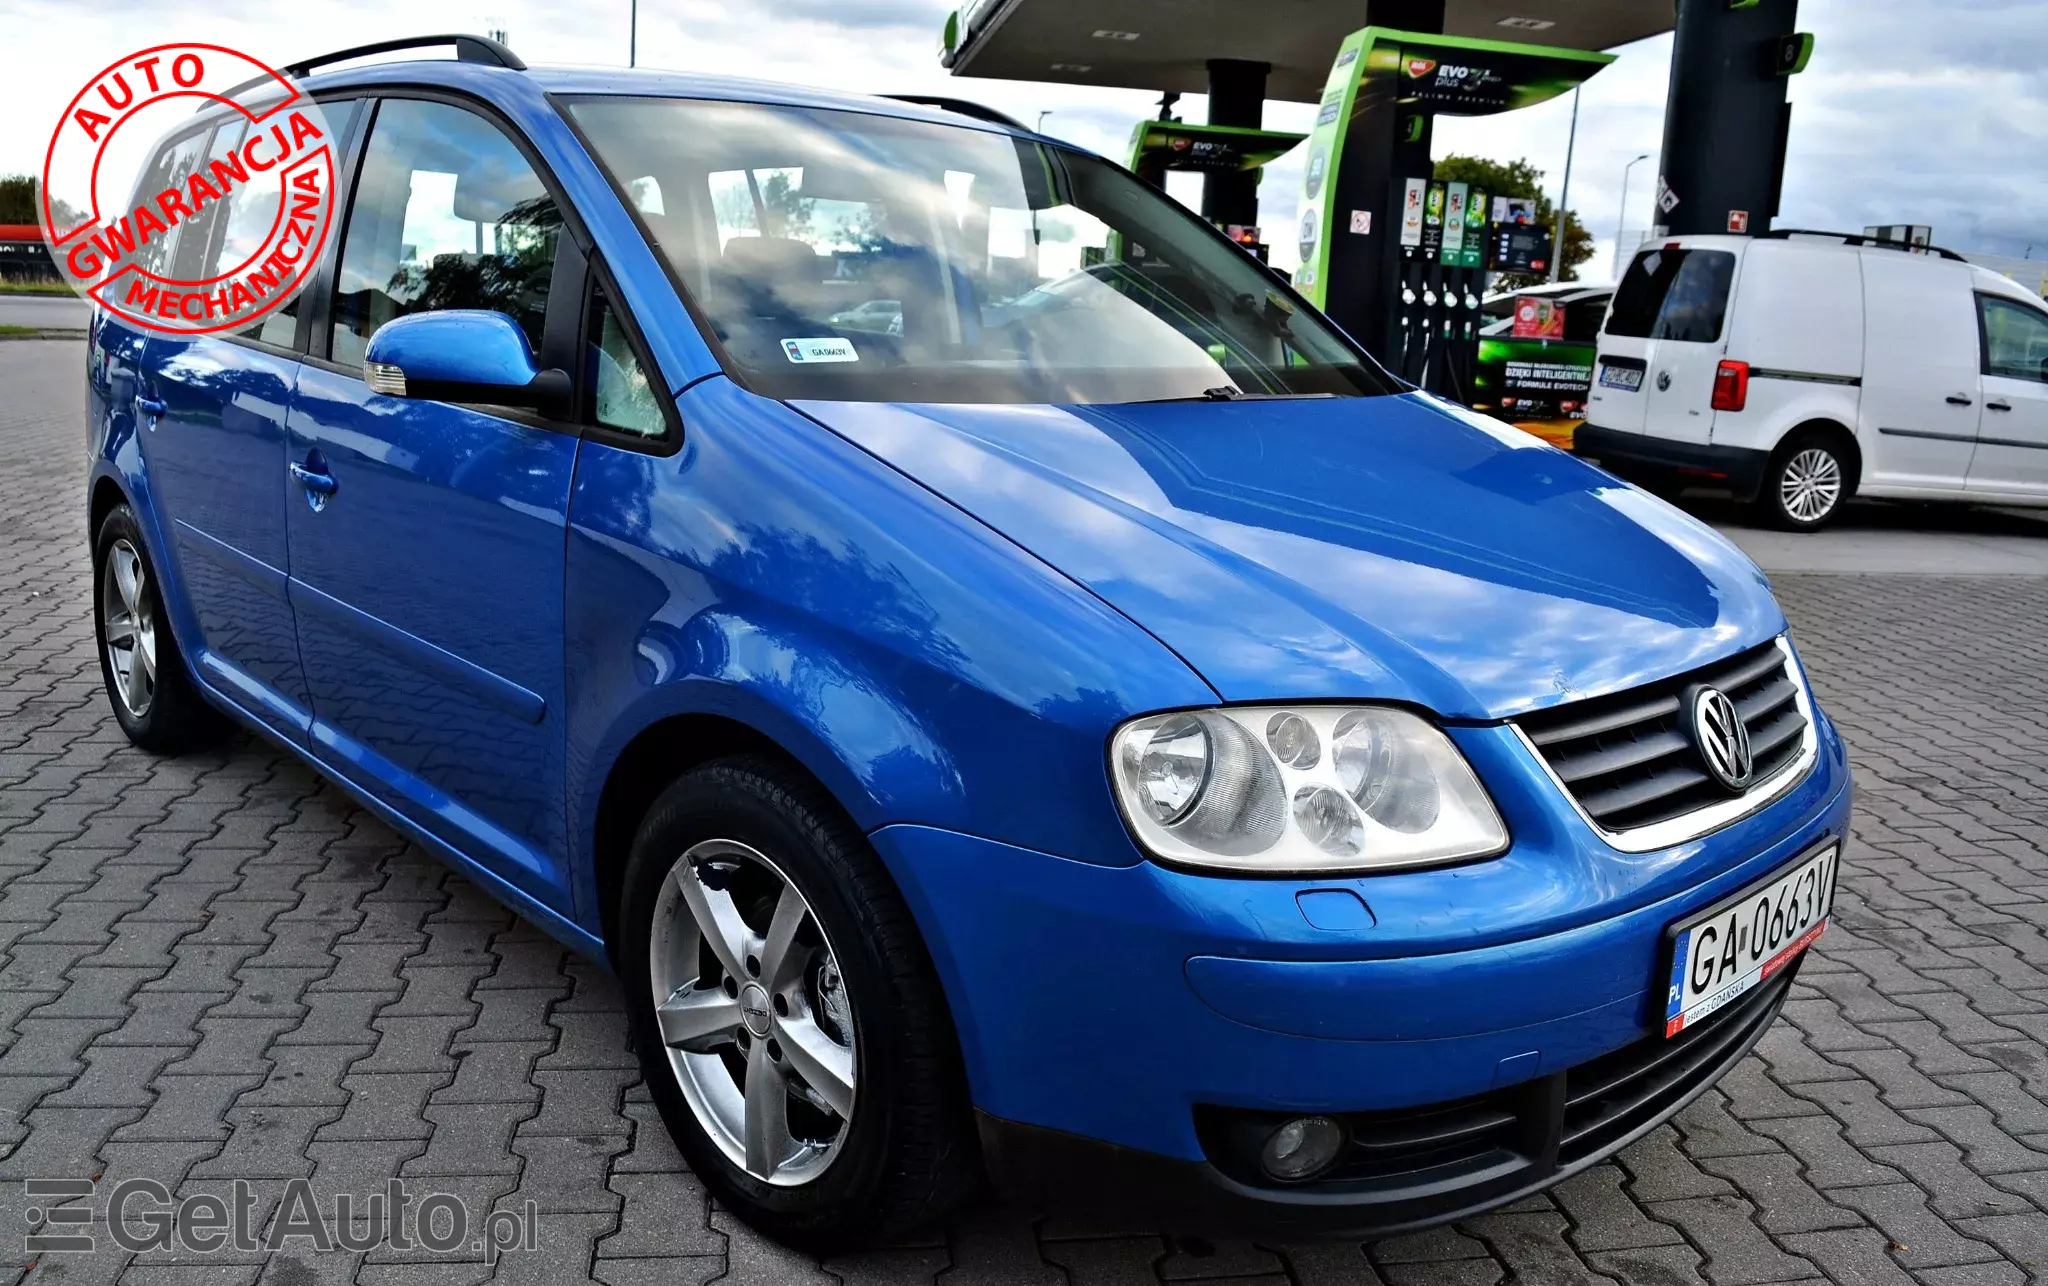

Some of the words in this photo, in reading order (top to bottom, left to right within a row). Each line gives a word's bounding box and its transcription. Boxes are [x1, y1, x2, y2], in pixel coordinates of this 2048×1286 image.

[1438, 64, 1469, 79] EVO
[1434, 77, 1461, 88] plus
[1457, 95, 1505, 105] PREMIUM
[1193, 141, 1213, 151] EVO
[1505, 367, 1531, 379] DZIĘKI
[1517, 380, 1552, 389] FORMULE
[1554, 382, 1588, 391] EVOTECH
[1690, 912, 1737, 995] GA
[1751, 854, 1833, 961] 0663V
[1668, 983, 1682, 1005] PL
